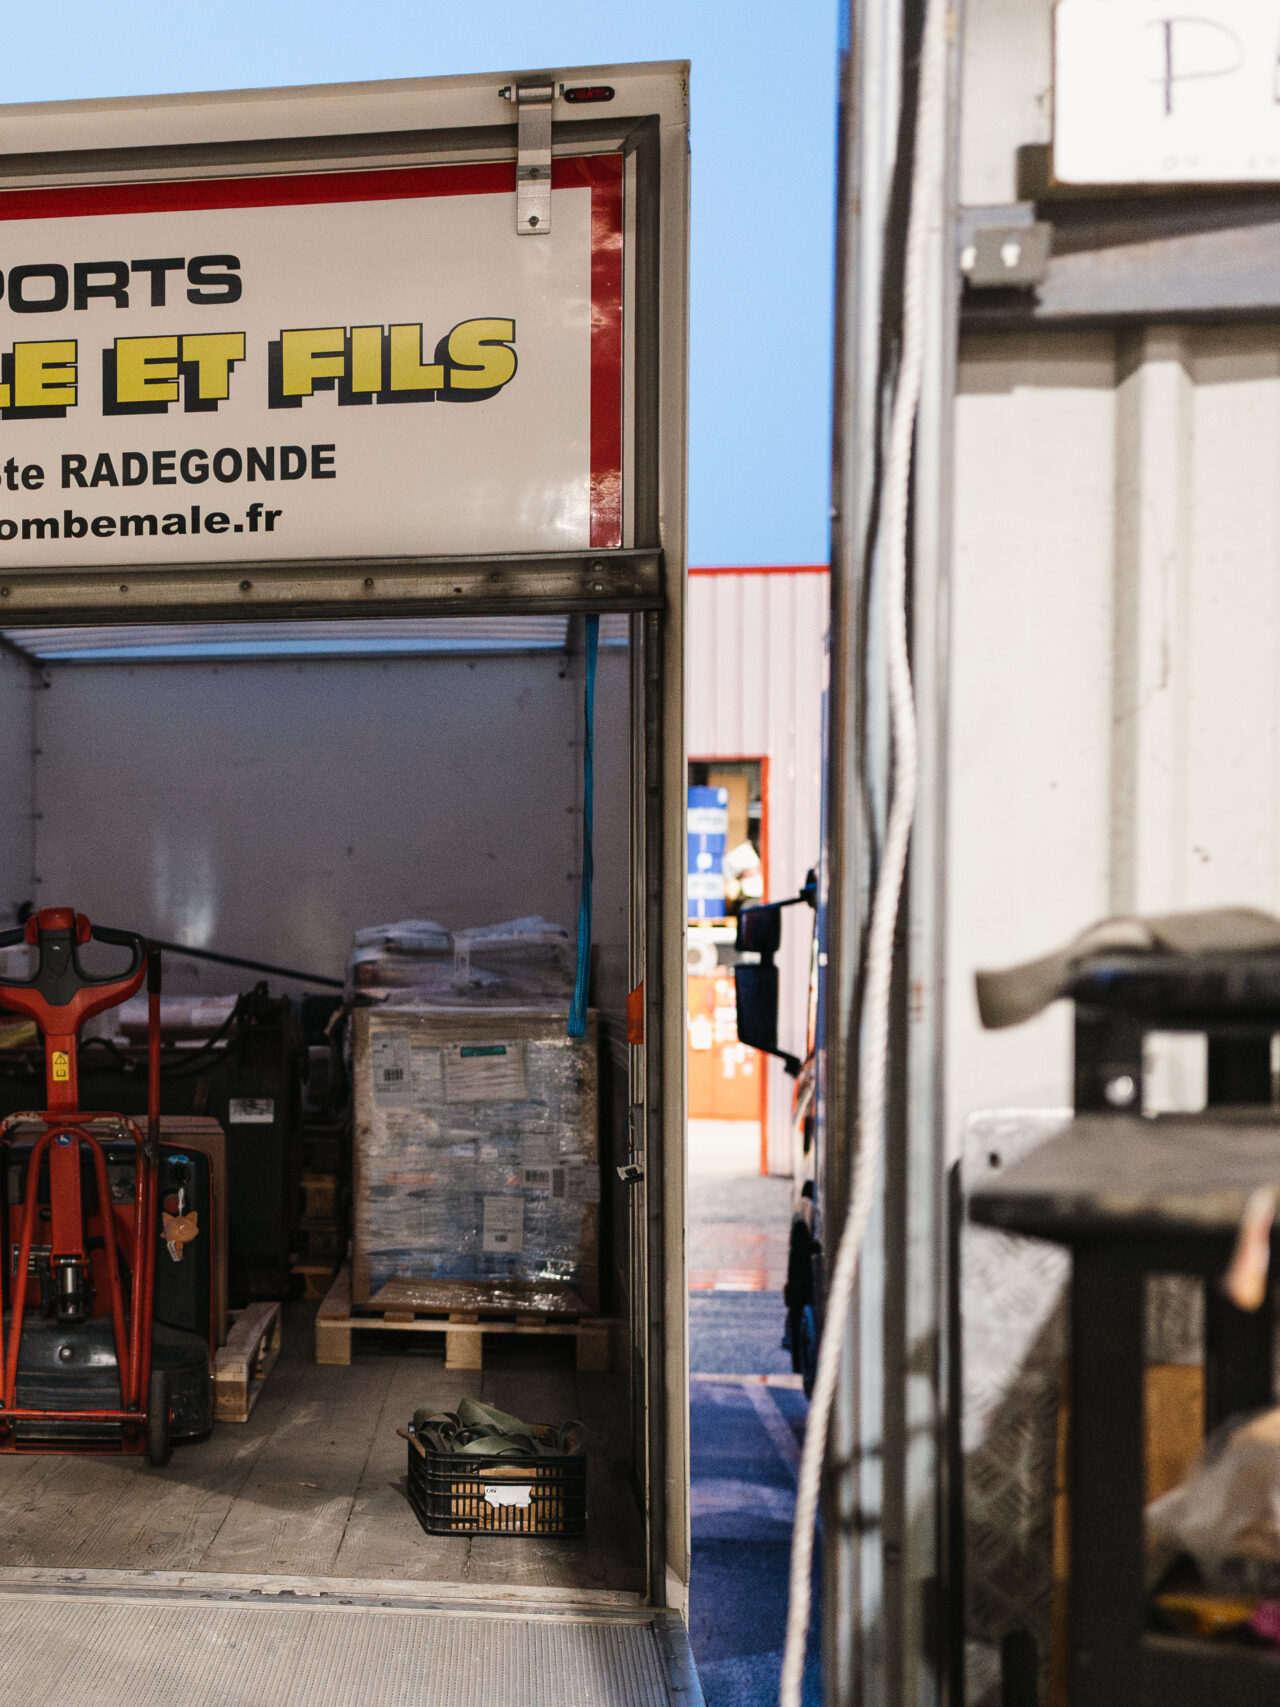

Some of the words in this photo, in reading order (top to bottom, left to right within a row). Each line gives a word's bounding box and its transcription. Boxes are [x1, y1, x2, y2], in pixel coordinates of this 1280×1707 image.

[103, 332, 246, 416] ET
[268, 317, 518, 409] FILS
[61, 443, 337, 489] RADEGONDE
